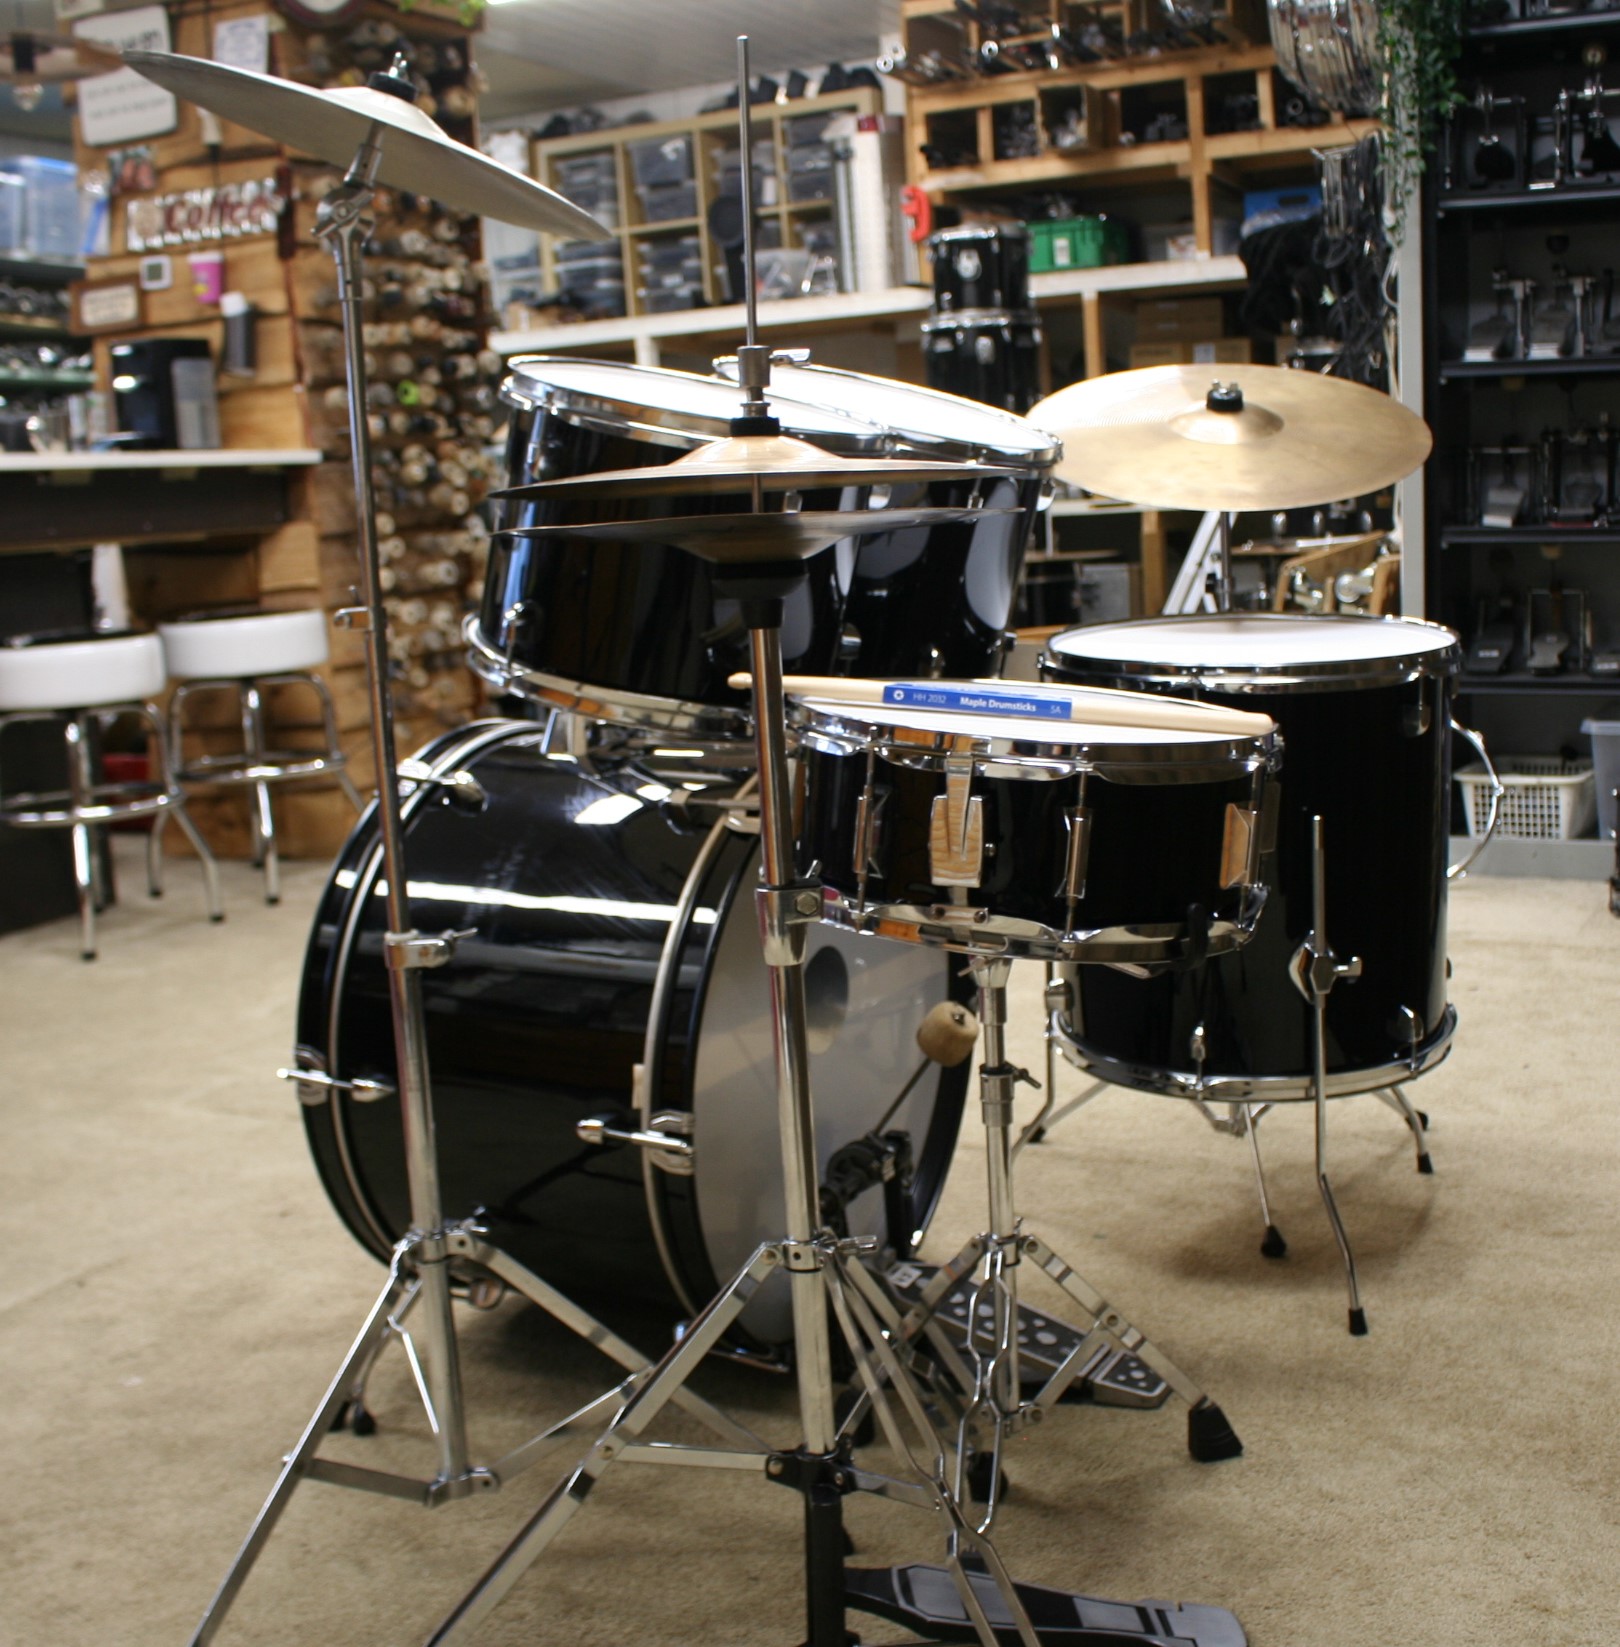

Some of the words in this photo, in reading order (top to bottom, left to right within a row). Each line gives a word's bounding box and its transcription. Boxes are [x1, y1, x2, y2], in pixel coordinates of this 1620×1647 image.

[912, 692, 927, 702] HH
[960, 696, 987, 708] Maple
[988, 698, 1037, 712] Drumsticks
[1050, 704, 1062, 714] 5A
